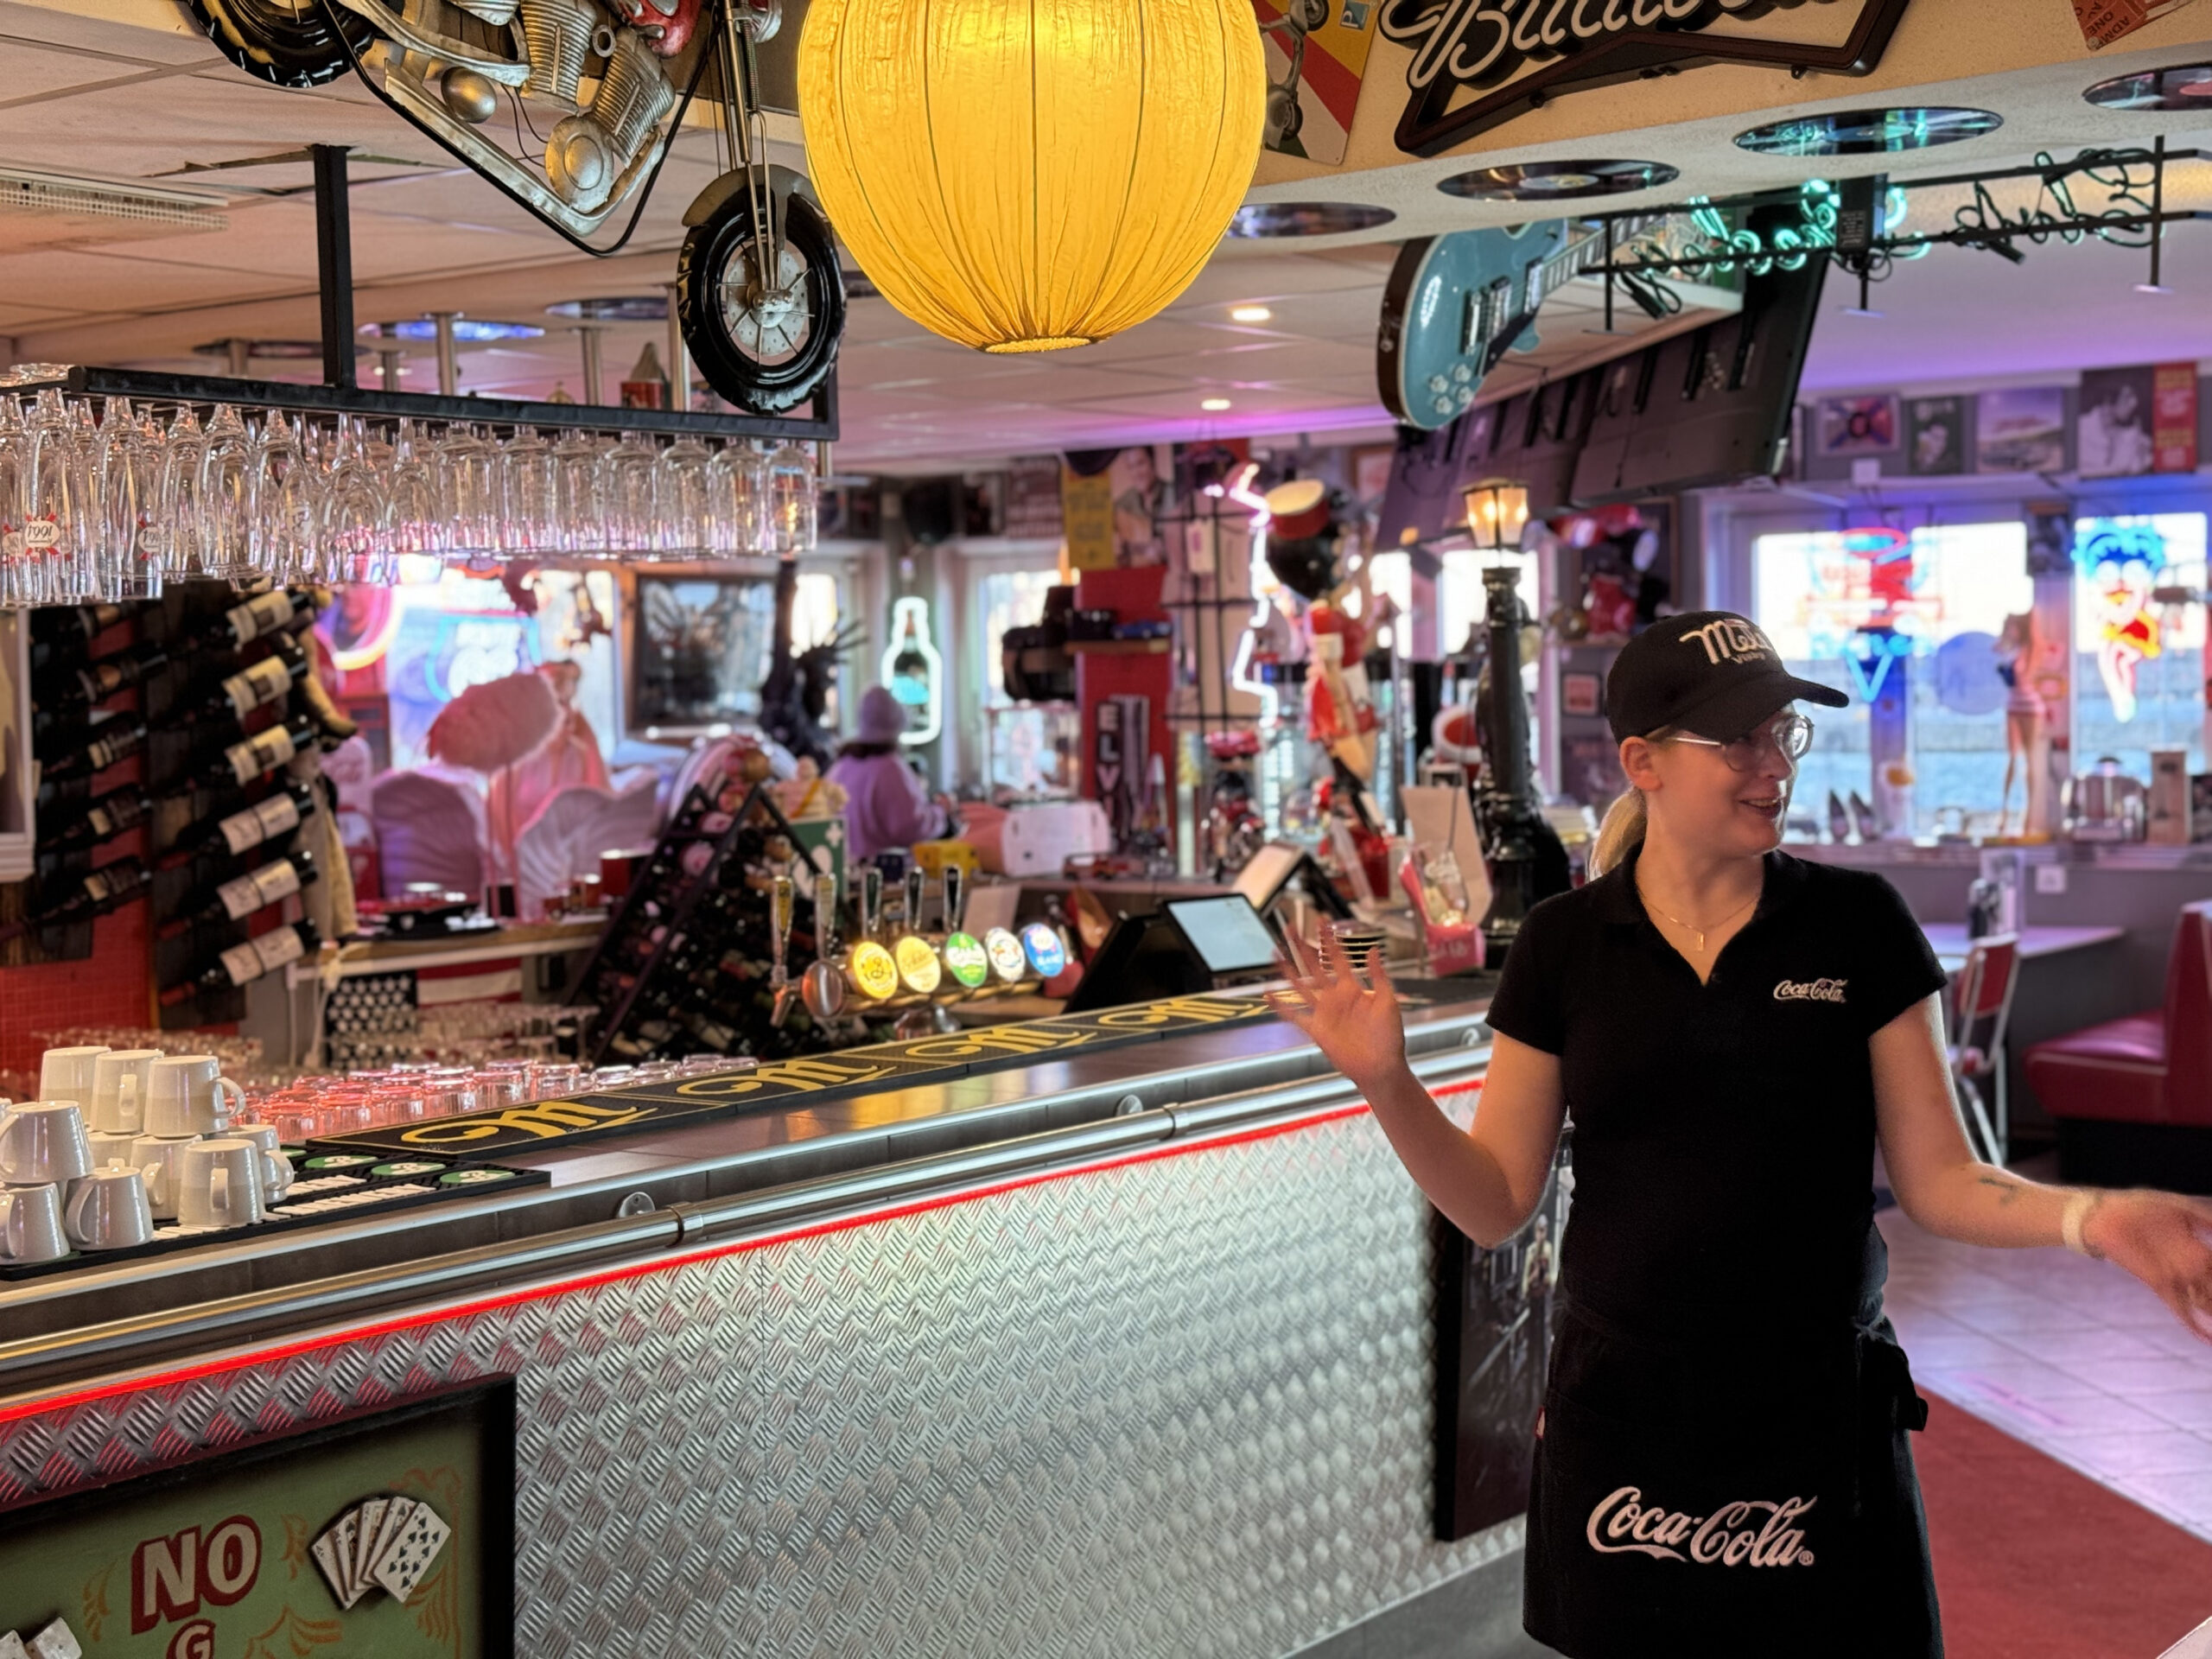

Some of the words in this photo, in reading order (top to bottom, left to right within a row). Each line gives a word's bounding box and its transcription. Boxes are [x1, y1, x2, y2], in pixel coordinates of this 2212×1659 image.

[2087, 11, 2114, 35] ONE
[1773, 977, 1848, 1003] Coca-Cola
[1586, 1485, 1818, 1567] Coca-Cola
[132, 1516, 262, 1634] NO
